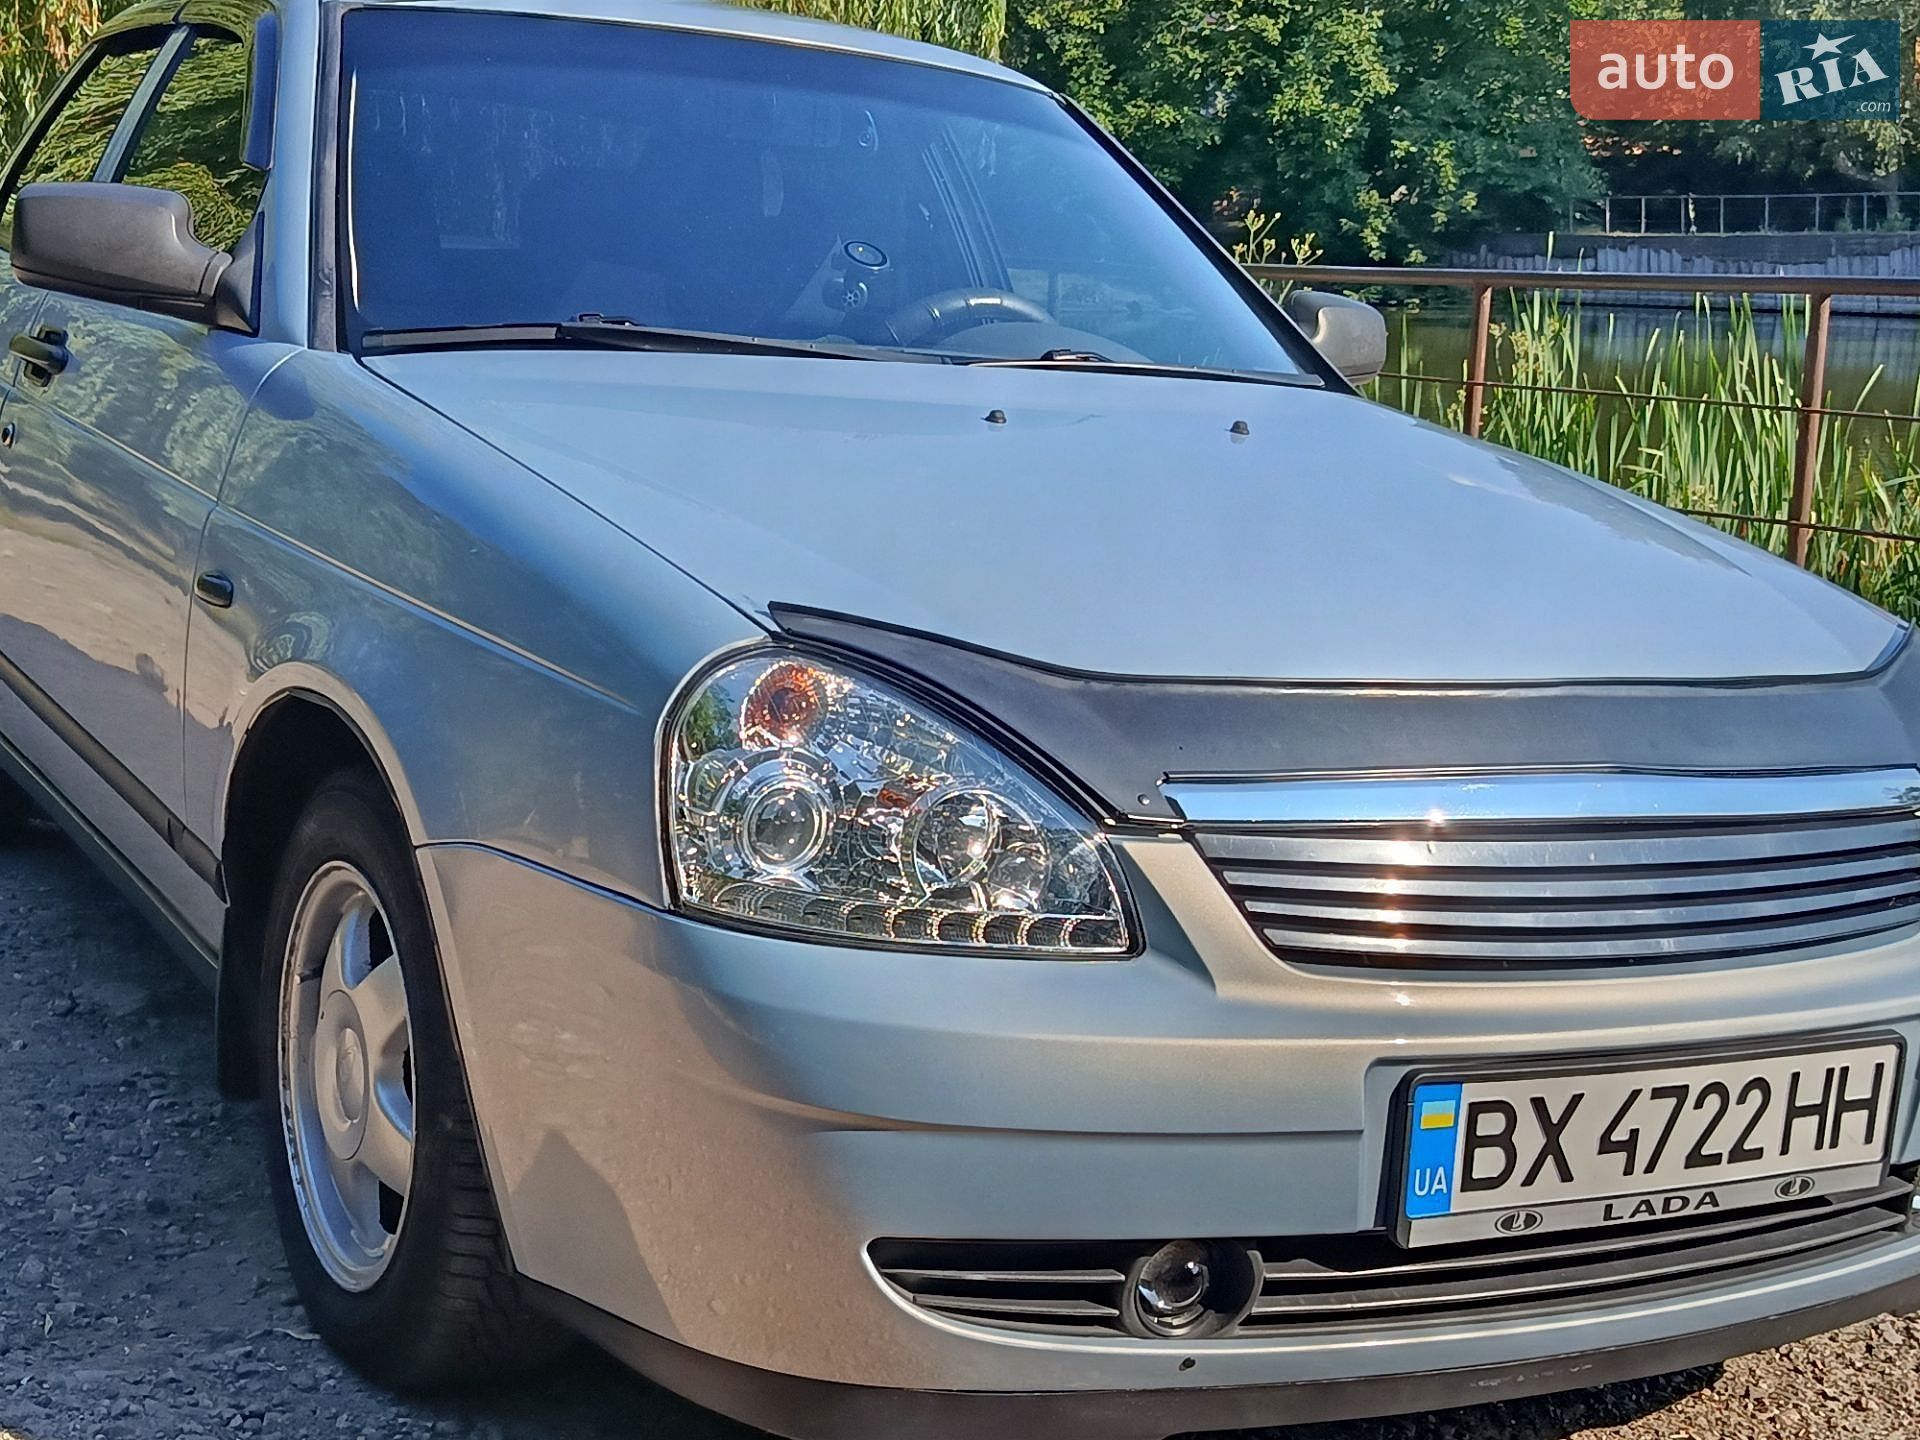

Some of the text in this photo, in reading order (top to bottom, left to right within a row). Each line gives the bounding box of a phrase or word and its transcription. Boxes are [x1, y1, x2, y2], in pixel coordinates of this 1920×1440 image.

[1459, 1062, 1885, 1193] BX 4722 HH
[1414, 1168, 1448, 1197] UA
[1602, 1191, 1720, 1223] LADA
